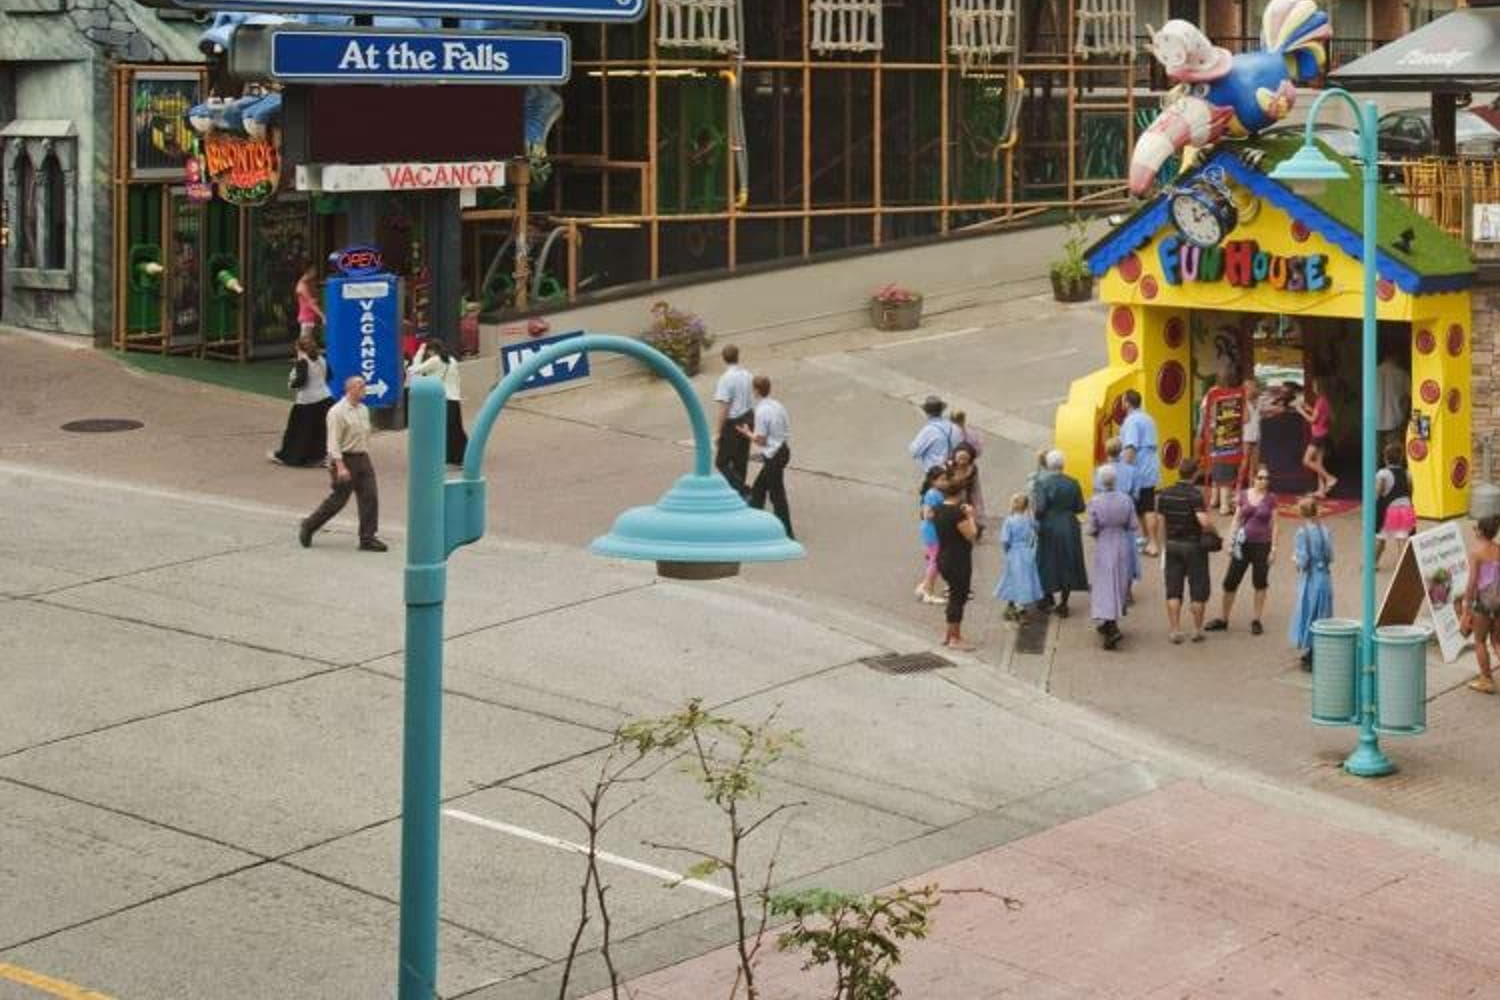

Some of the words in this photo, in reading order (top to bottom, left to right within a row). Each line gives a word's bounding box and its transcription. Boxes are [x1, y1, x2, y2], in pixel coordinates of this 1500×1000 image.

[338, 40, 379, 69] At
[387, 42, 436, 70] the
[443, 42, 509, 72] Falls
[384, 165, 497, 188] VACANCY
[339, 252, 382, 269] OPEN
[1158, 234, 1224, 287] FUN
[1225, 239, 1332, 293] HOUSE
[360, 300, 376, 382] VACANCY
